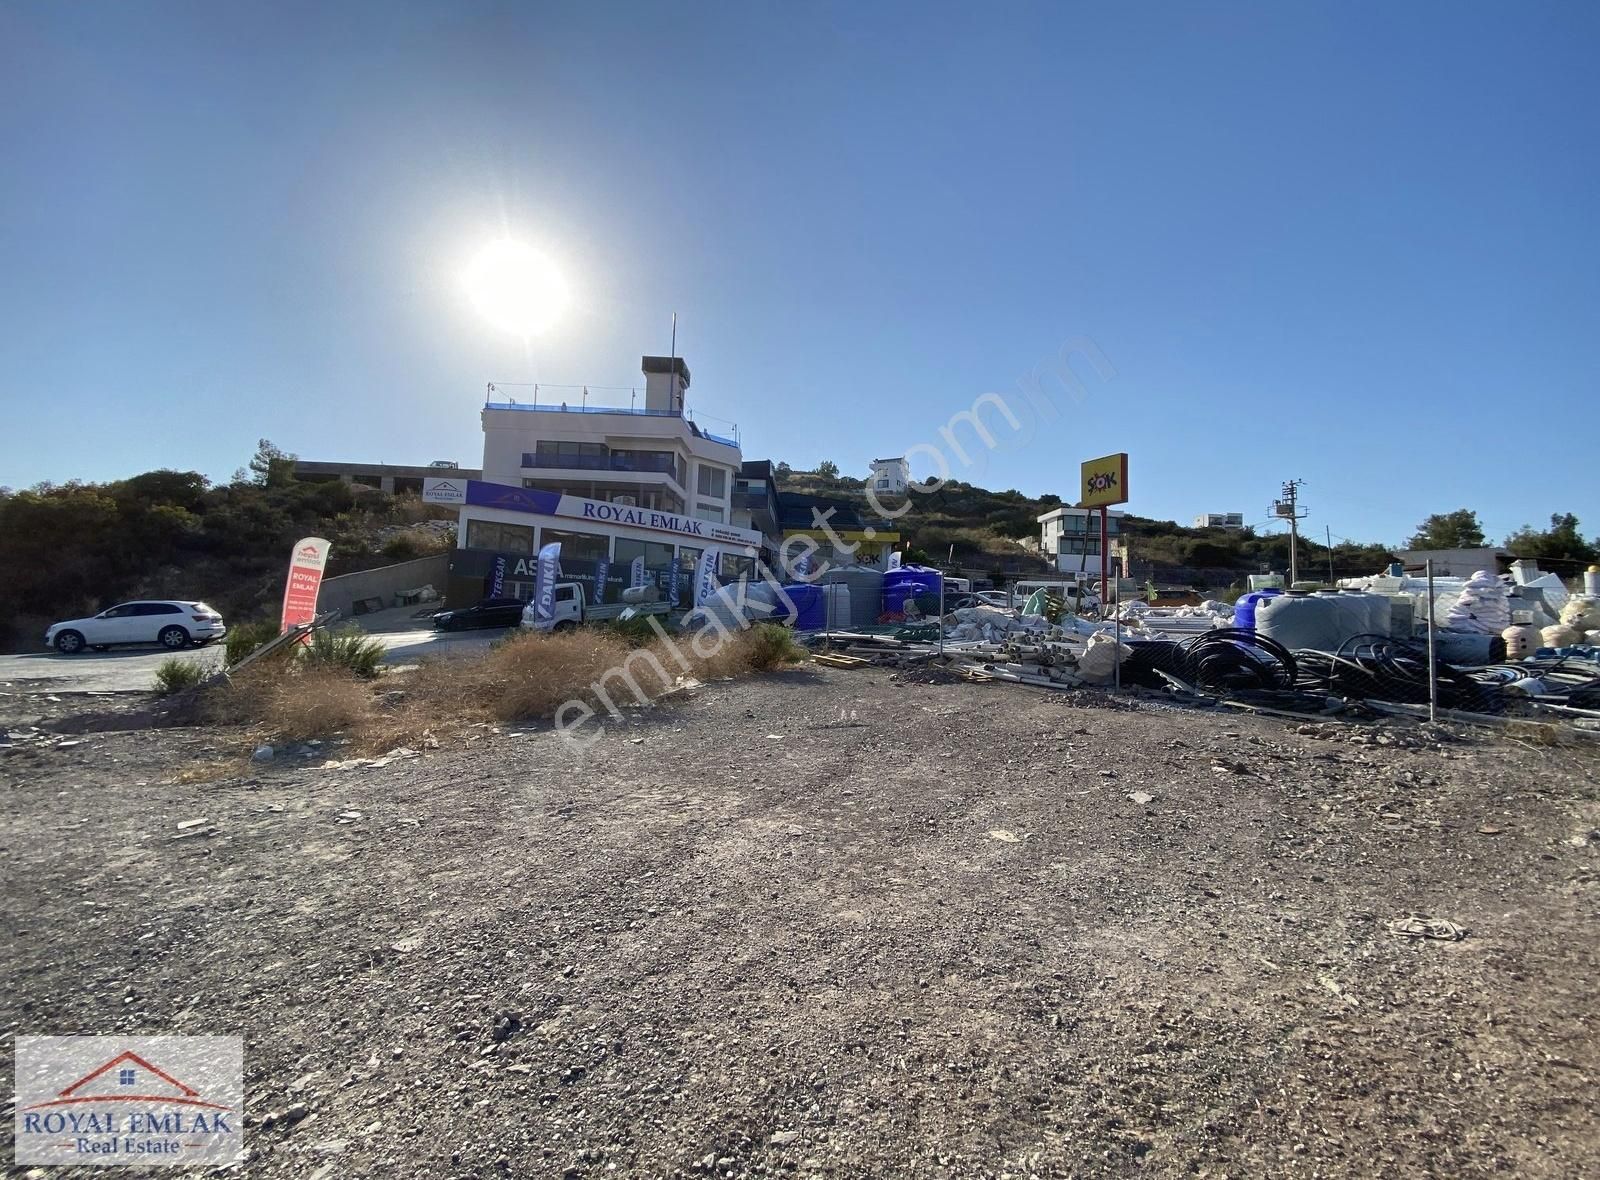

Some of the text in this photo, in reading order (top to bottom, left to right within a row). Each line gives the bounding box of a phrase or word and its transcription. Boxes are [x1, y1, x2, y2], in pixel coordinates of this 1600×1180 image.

[583, 502, 702, 535] ROYAL EMLAK
[292, 572, 318, 582] ROYAL
[513, 558, 564, 578] ASA
[541, 552, 554, 606] DAIKIN
[700, 553, 714, 599] DAIKIN
[292, 582, 315, 591] EMLAK
